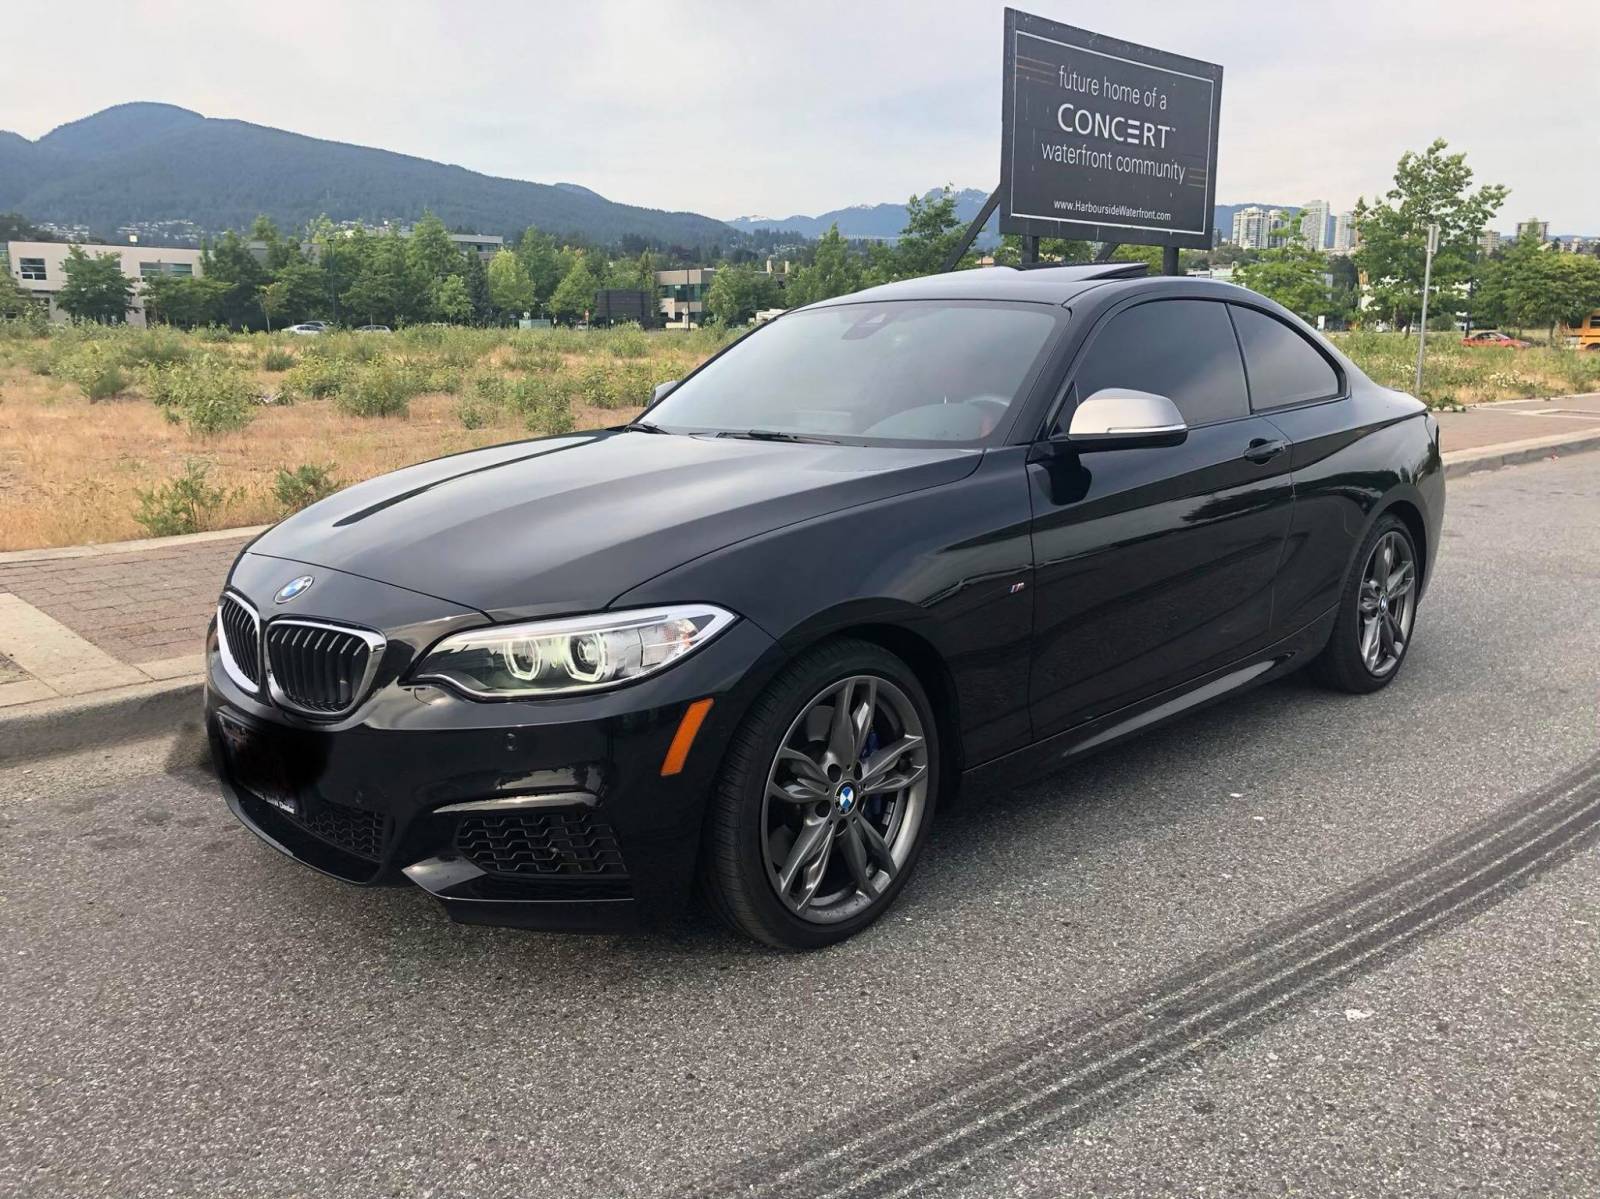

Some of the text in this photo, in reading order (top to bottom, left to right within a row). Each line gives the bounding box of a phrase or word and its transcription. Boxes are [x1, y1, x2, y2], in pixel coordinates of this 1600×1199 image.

[1059, 65, 1167, 110] future home of a
[1057, 103, 1171, 149] CONCERT
[1041, 143, 1185, 184] waterfront community
[1053, 200, 1171, 220] www.HarboursideWaterfront.com
